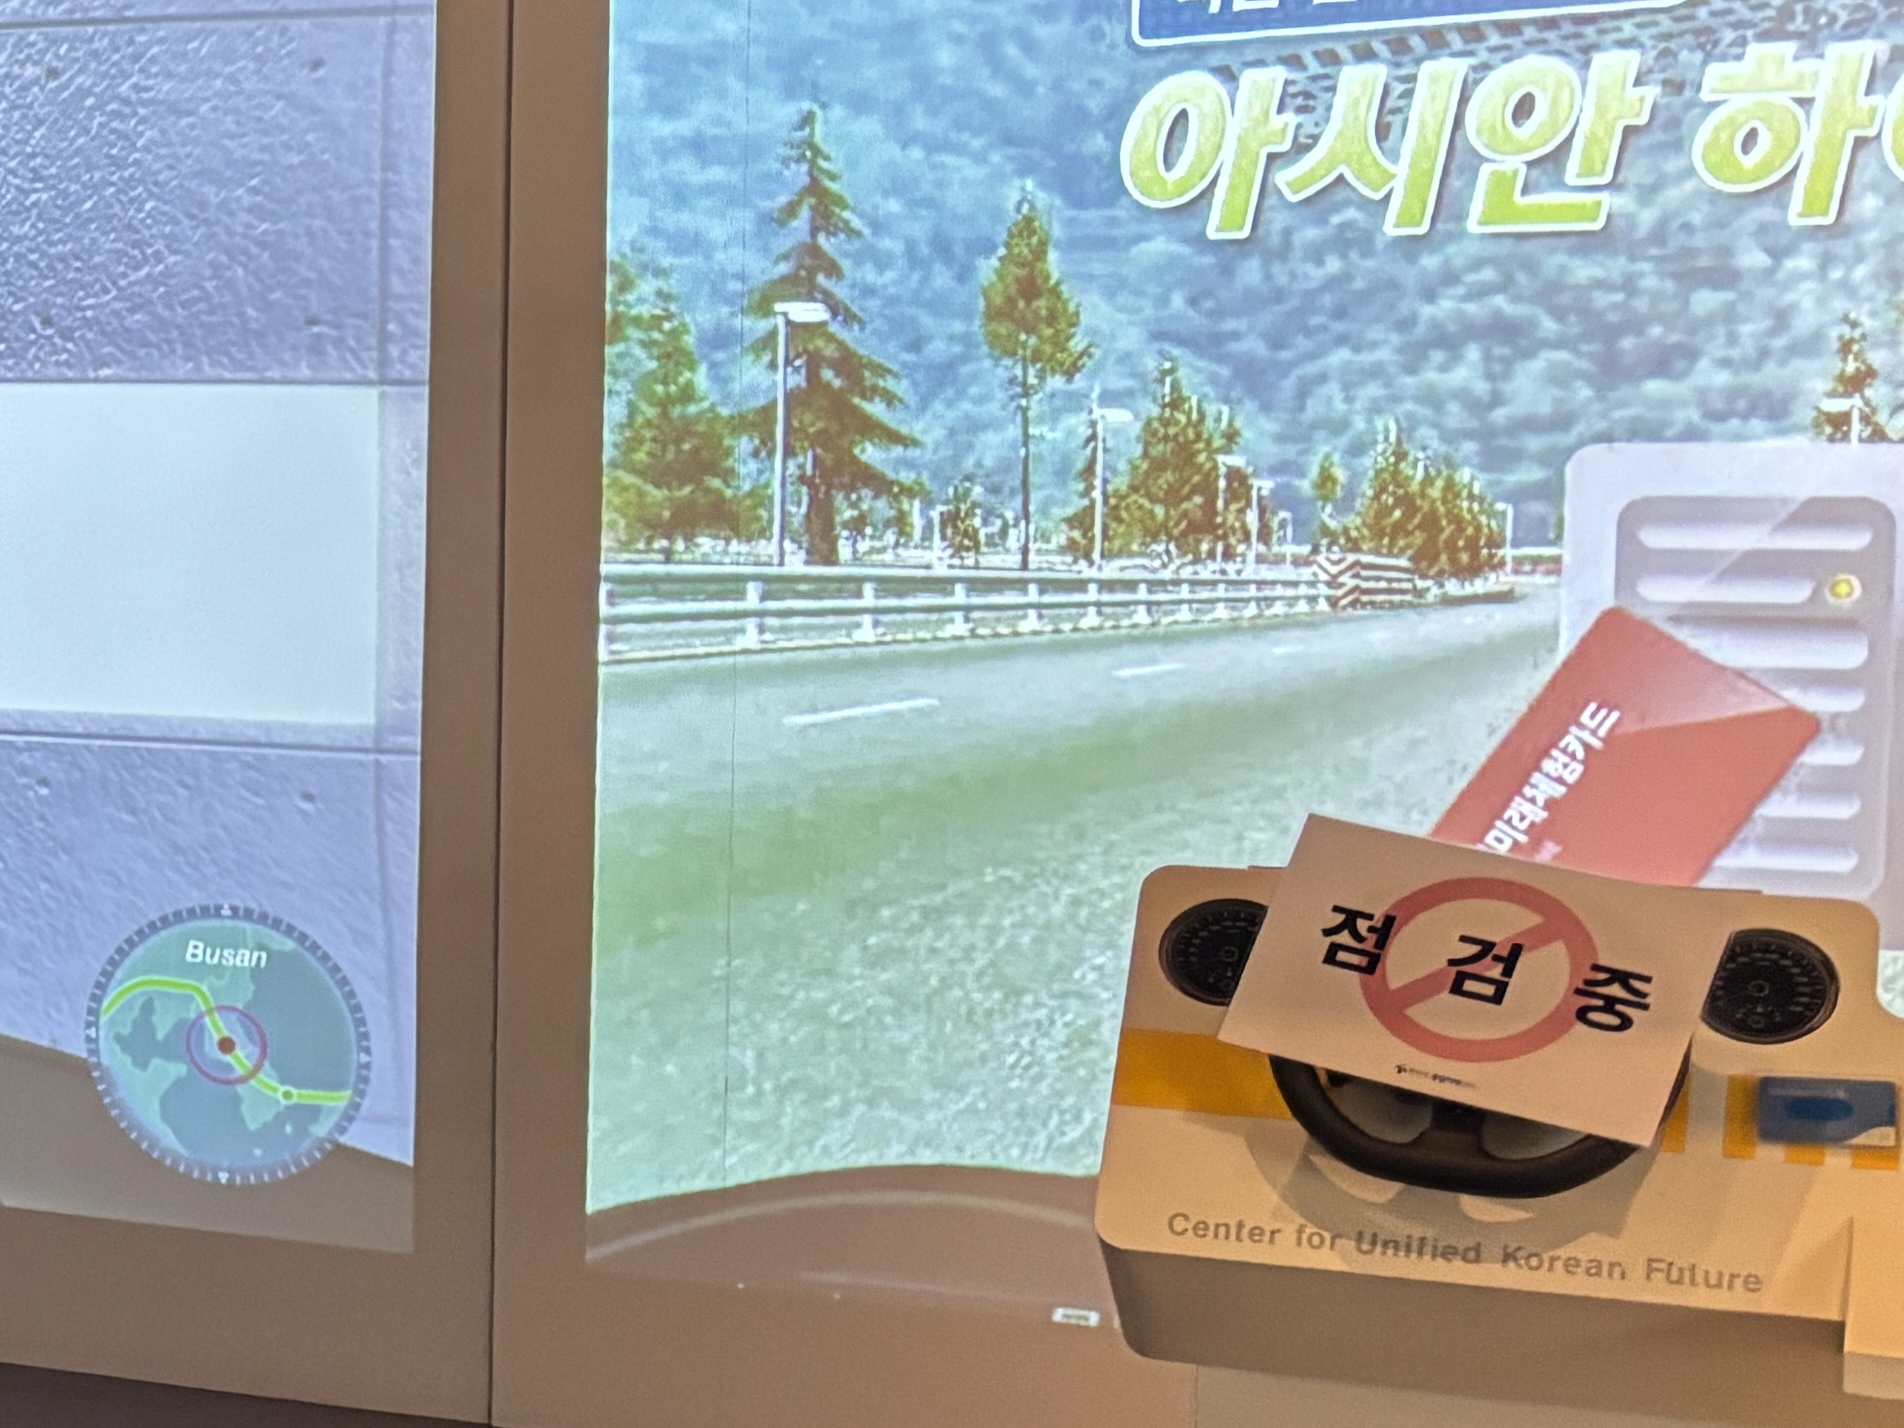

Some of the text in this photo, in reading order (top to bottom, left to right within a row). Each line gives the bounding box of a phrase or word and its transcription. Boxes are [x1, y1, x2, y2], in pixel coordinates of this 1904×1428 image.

[1120, 40, 1904, 240] 아시안 하
[185, 939, 267, 969] Busan
[1167, 1212, 1764, 1294] Center for Unified Korean Future
